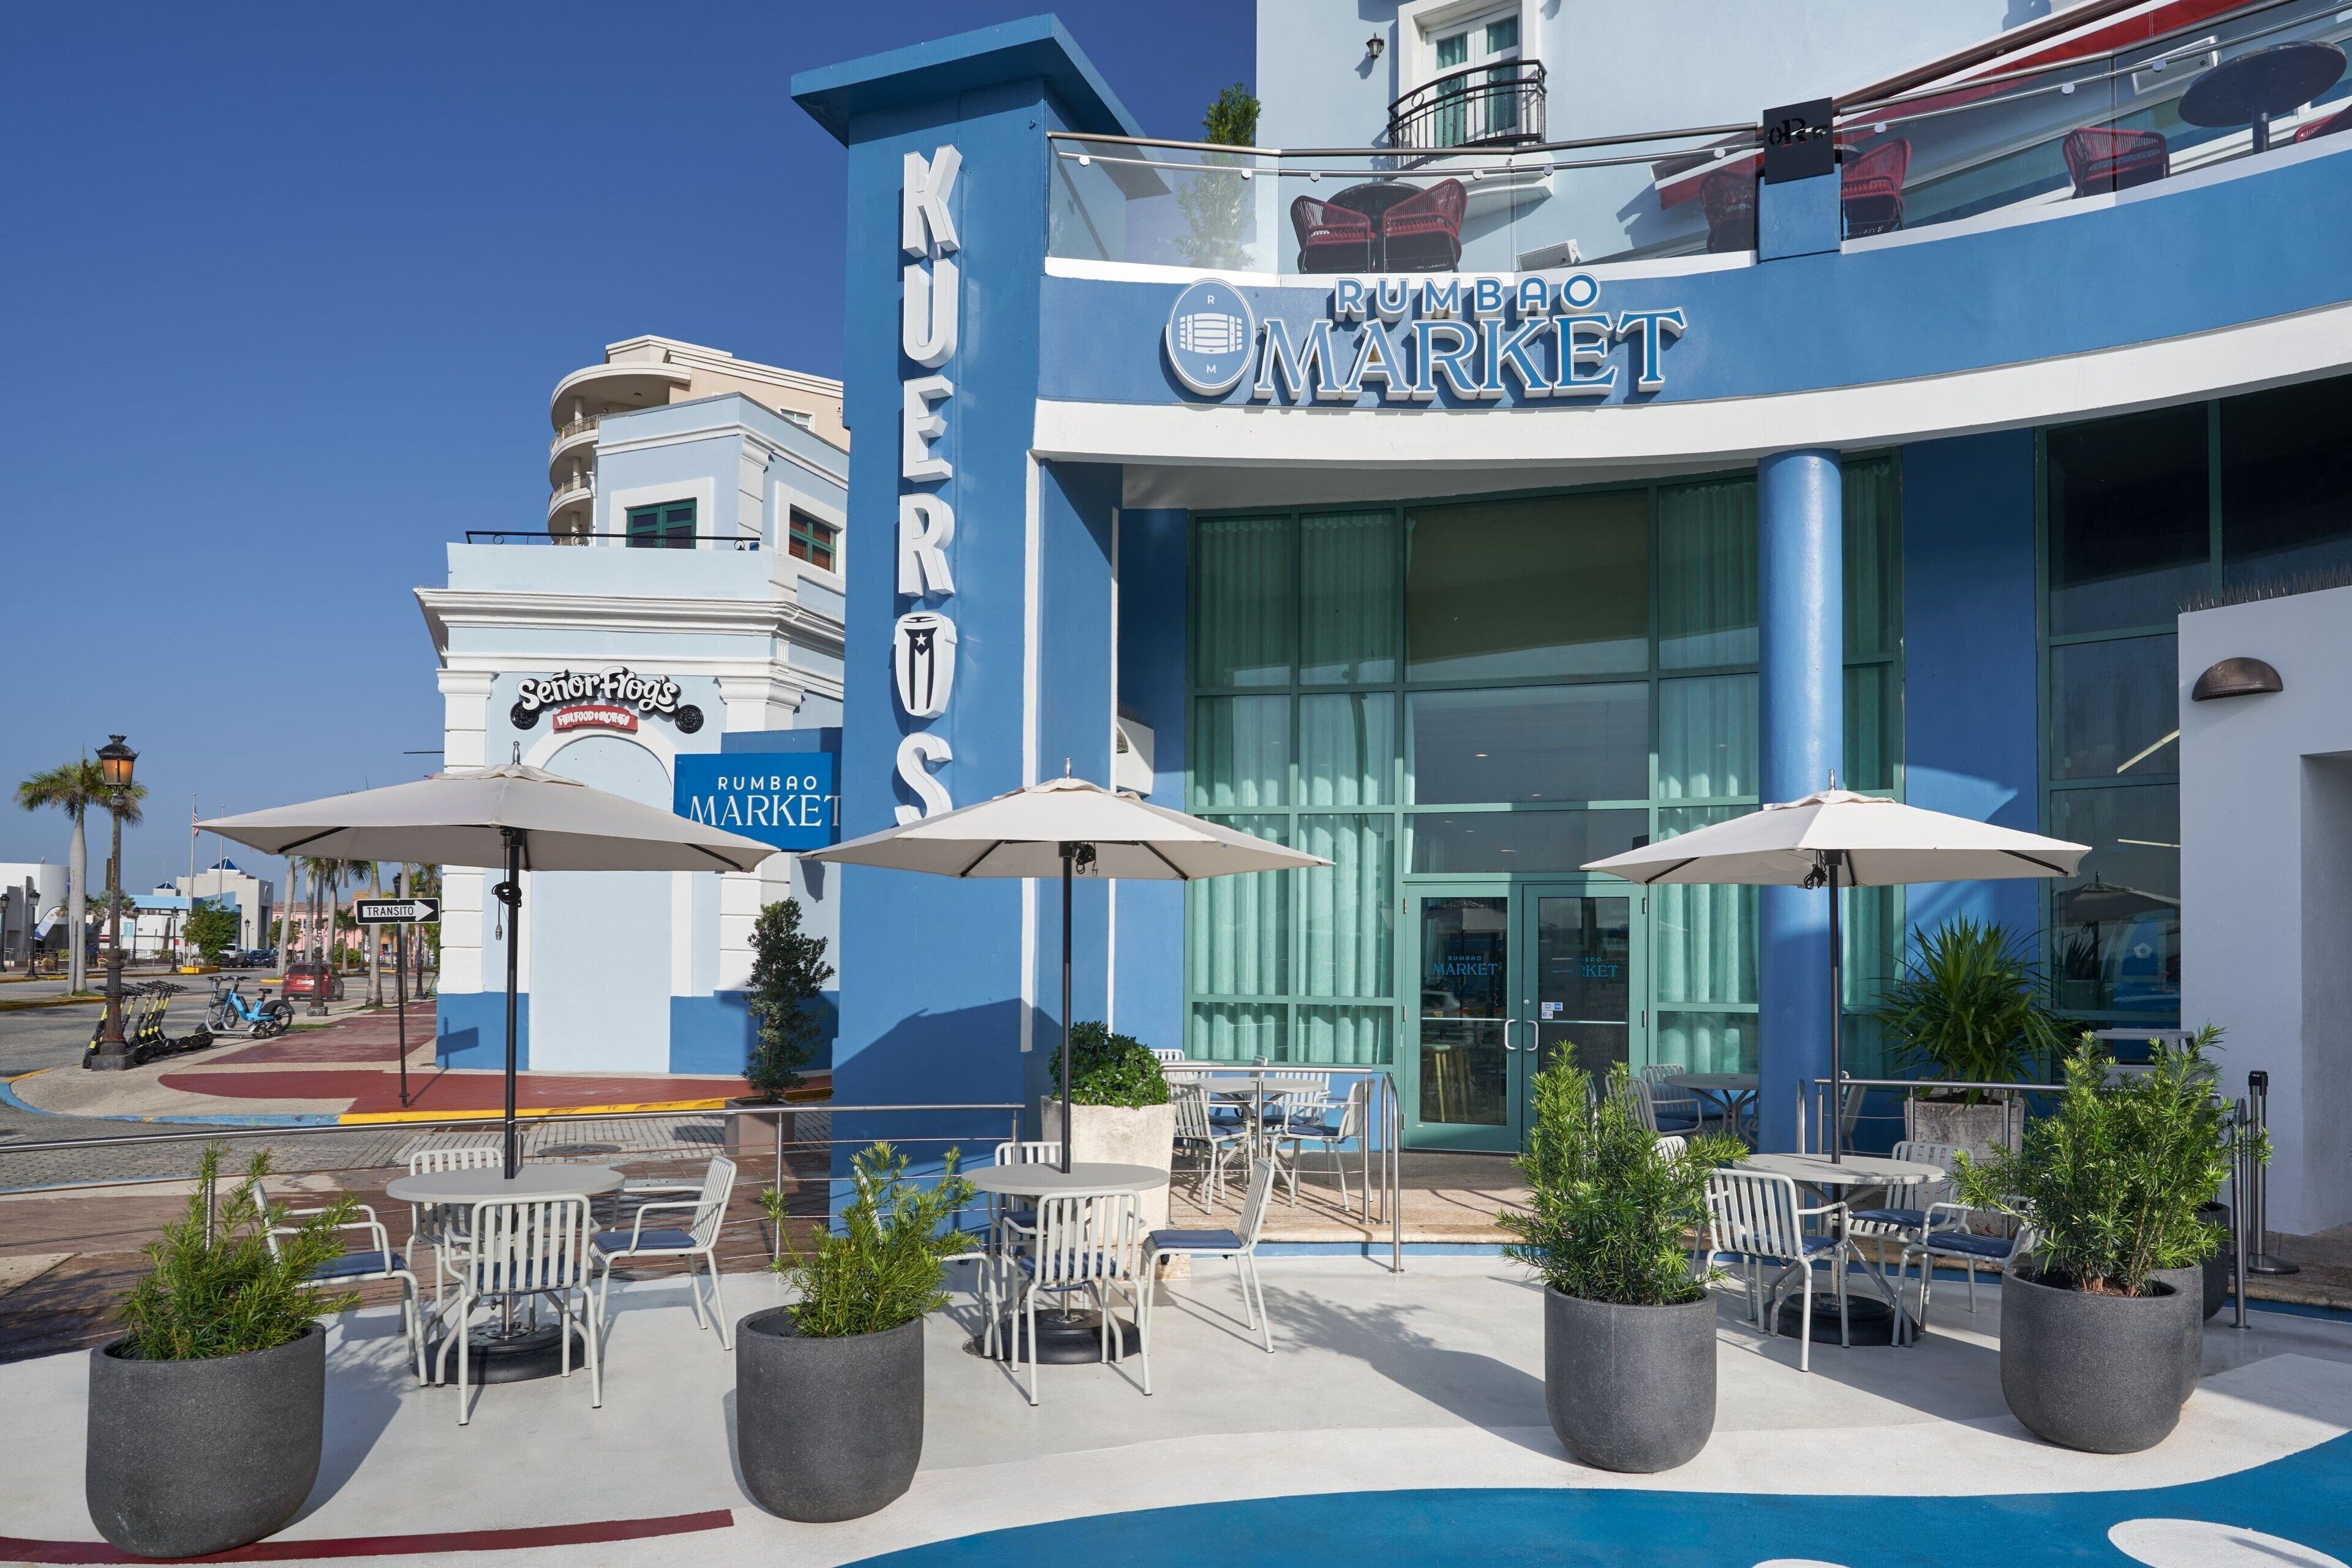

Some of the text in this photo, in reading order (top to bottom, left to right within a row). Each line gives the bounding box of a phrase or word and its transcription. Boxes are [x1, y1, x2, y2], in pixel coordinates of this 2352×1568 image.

[1207, 295, 1215, 304] R
[1335, 273, 1601, 321] RUMBAO
[1254, 306, 1687, 401] MARKET
[1206, 364, 1216, 374] M
[894, 145, 963, 826] KUEROS
[516, 666, 677, 714] Señor Frog's
[718, 775, 817, 790] RUMBAO
[690, 794, 842, 827] MARKET
[367, 907, 413, 916] TRANSITO
[1433, 963, 1498, 975] MARKET
